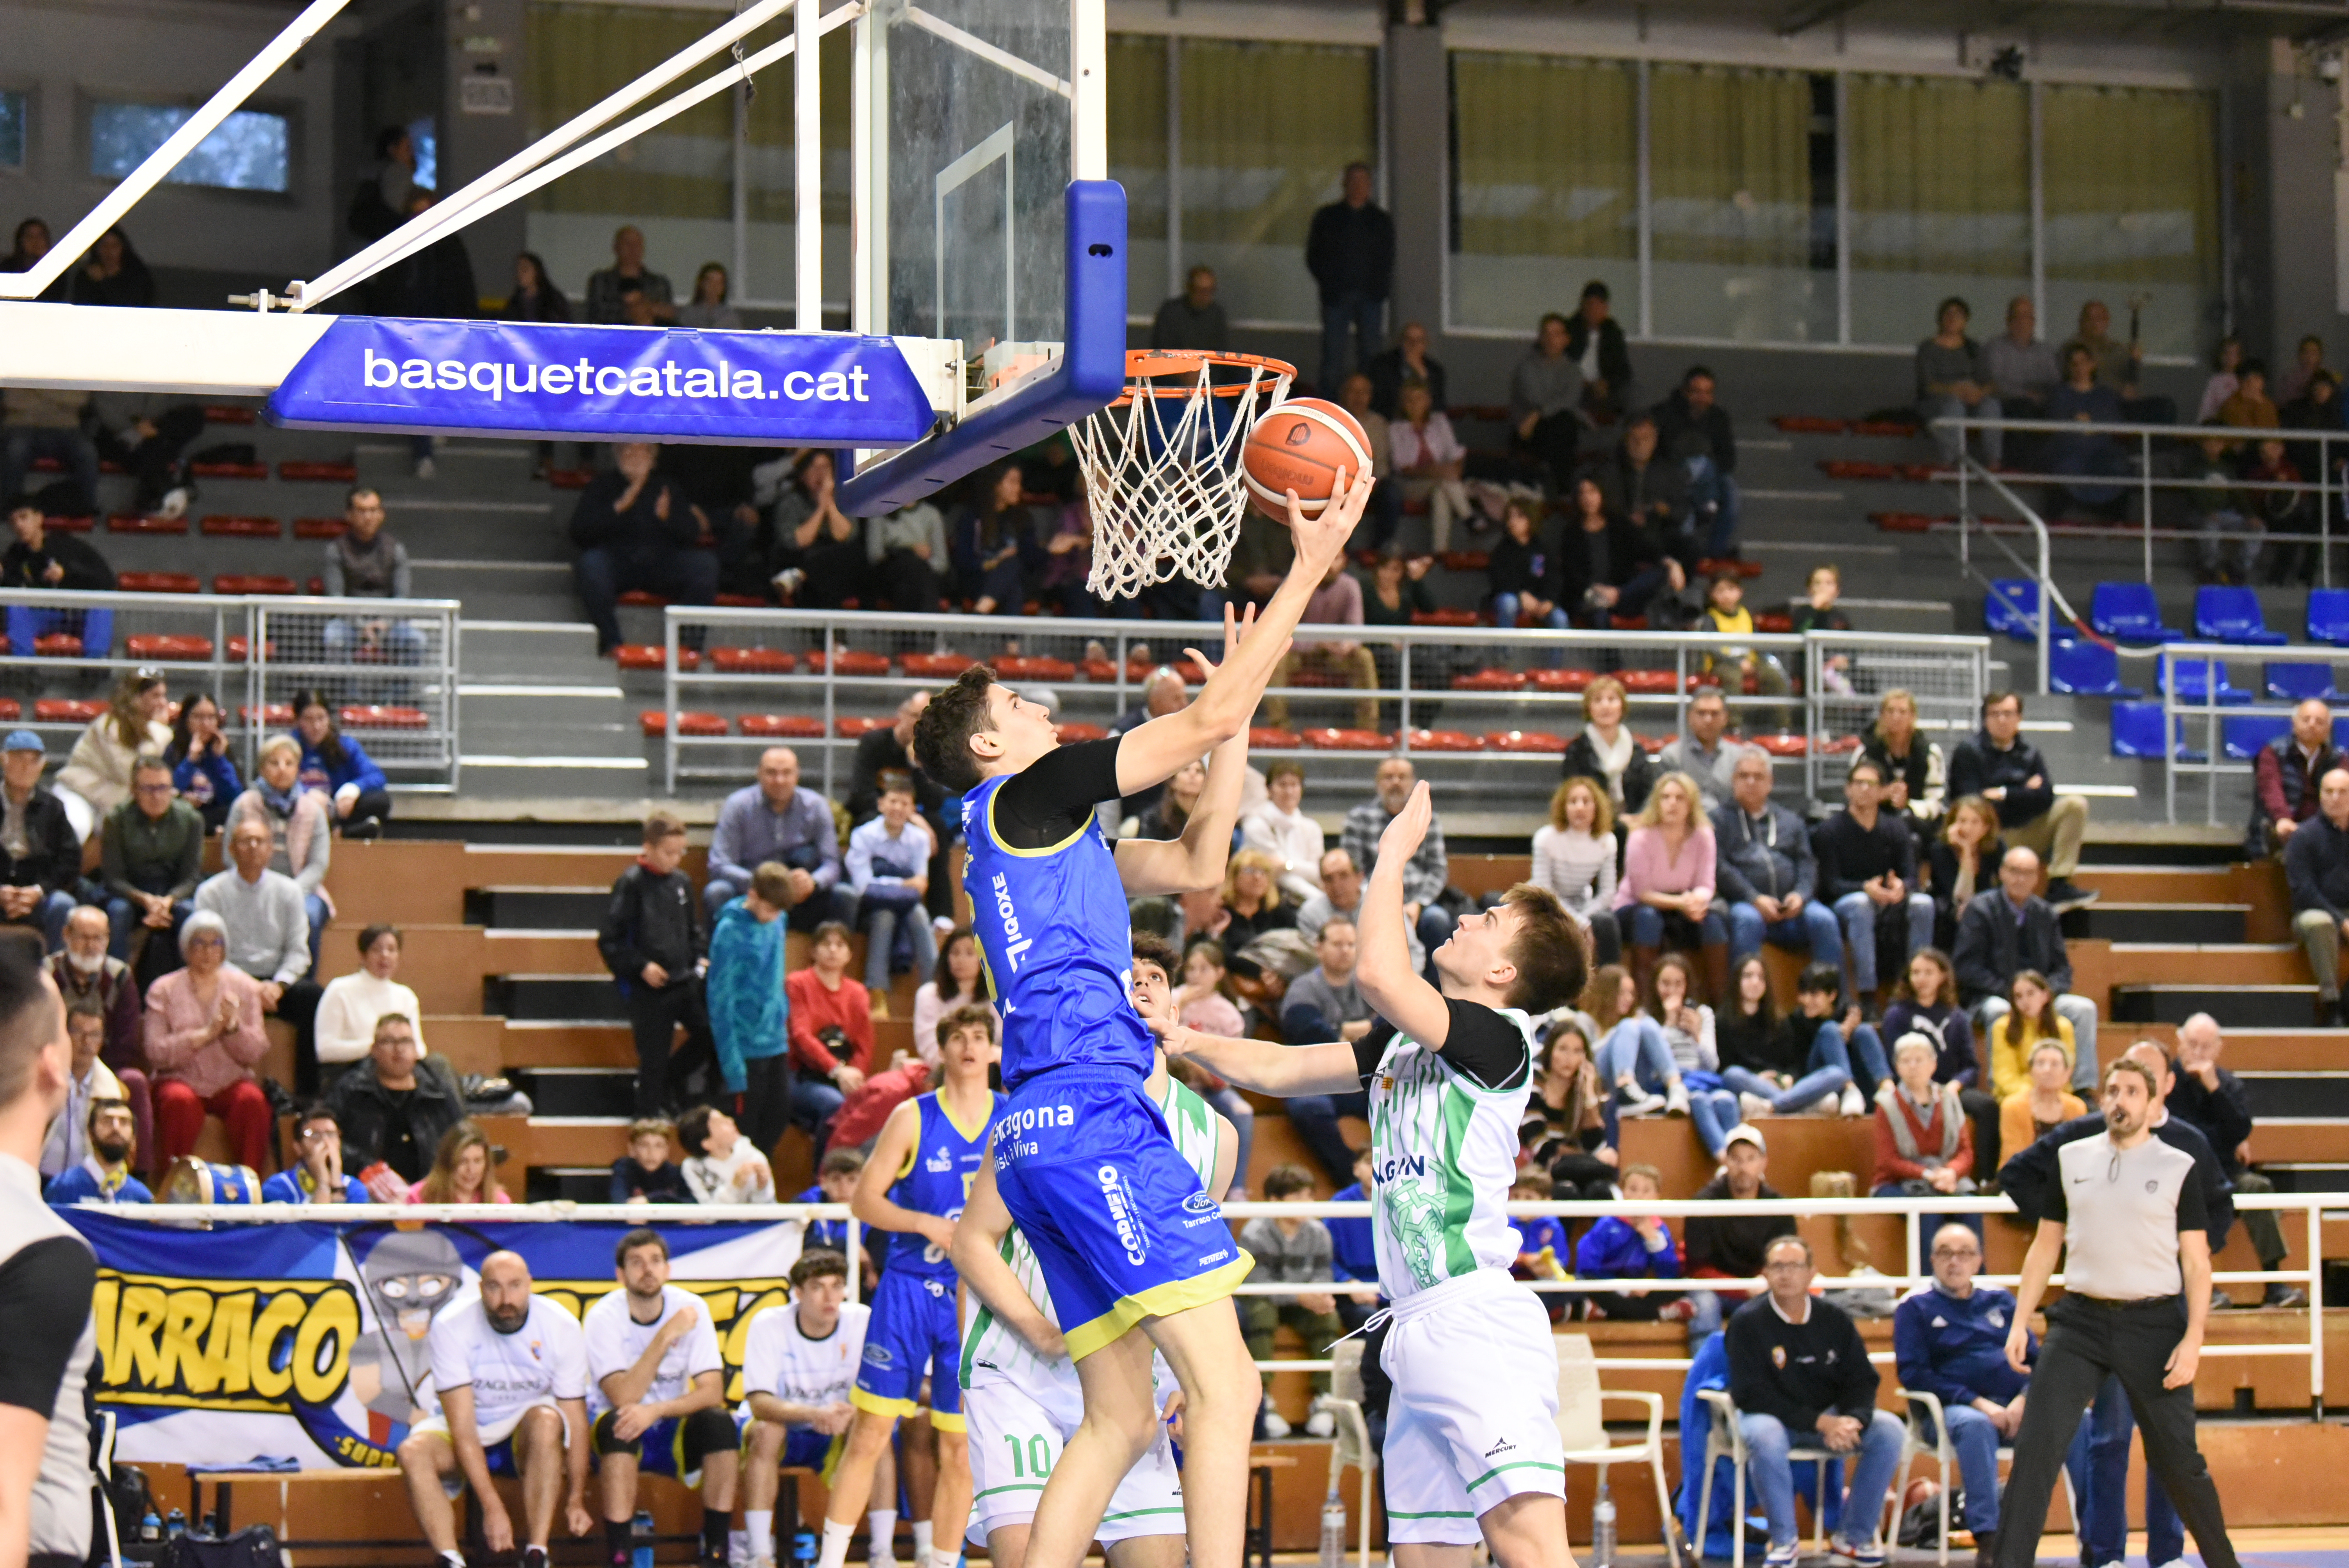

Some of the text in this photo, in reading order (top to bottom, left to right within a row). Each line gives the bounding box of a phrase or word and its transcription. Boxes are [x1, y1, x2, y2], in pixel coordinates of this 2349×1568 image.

[364, 349, 869, 402] basquetcatala.cat
[992, 871, 1022, 943] IQOXE
[1013, 1140, 1038, 1158] Viva
[1122, 1175, 1138, 1211] EXCAVACIONES
[1136, 1214, 1151, 1249] TRANSPORTES
[1182, 1215, 1210, 1228] Tarraco
[1199, 1251, 1224, 1267] PENTEX
[1004, 1433, 1051, 1478] 10
[1485, 1444, 1517, 1458] MERCURY
